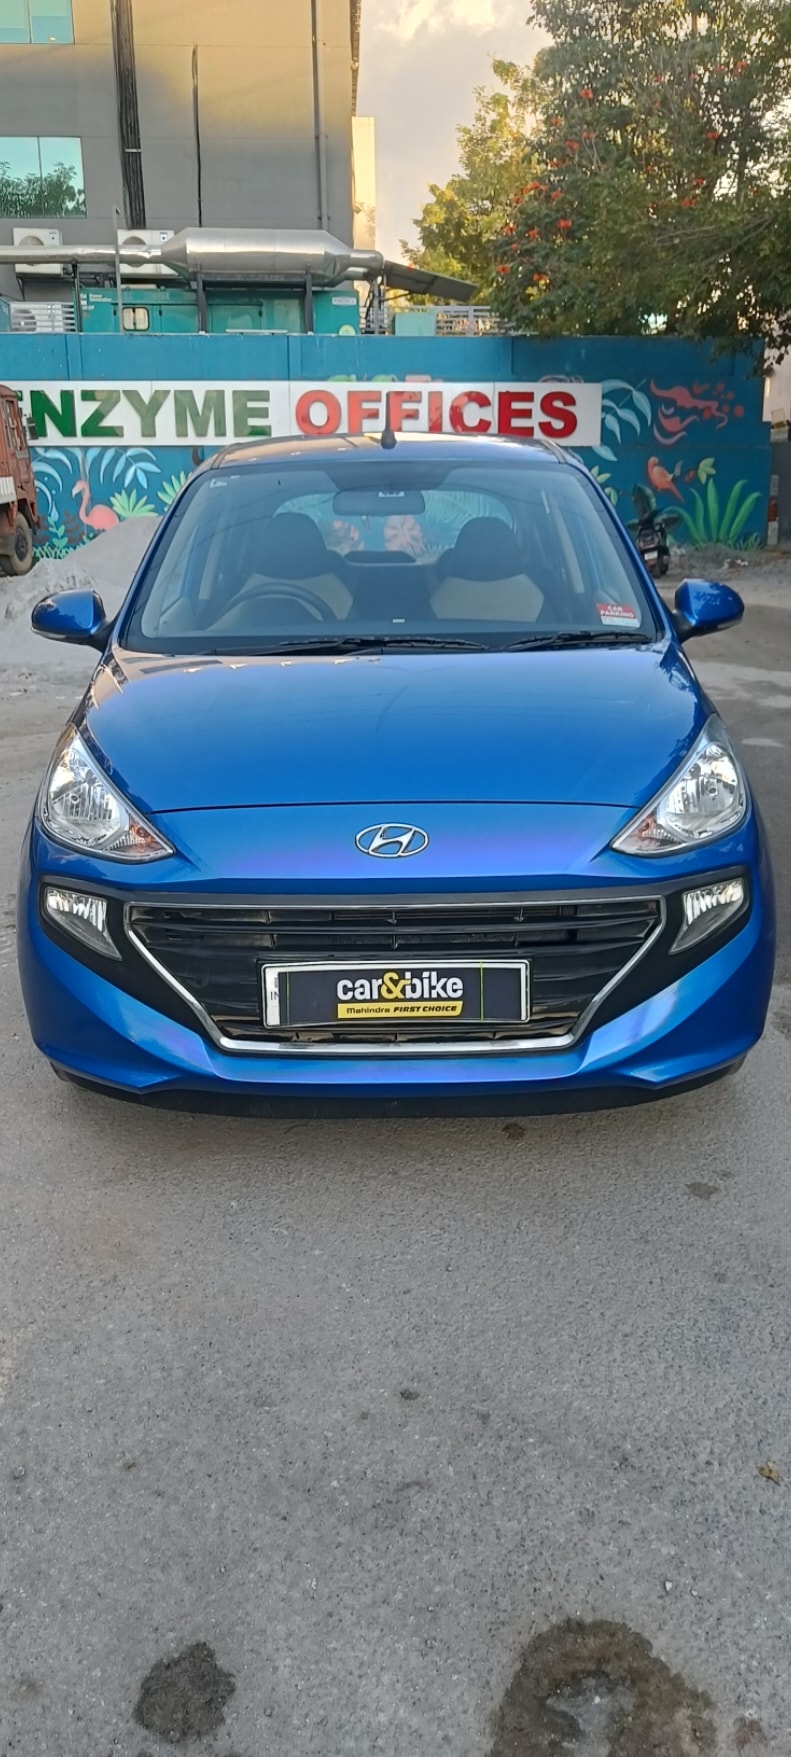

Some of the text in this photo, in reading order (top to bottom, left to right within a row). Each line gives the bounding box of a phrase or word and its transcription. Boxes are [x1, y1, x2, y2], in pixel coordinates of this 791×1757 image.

[16, 389, 578, 439] NZYME OFFICES
[600, 610, 634, 618] PARKING
[337, 971, 464, 1001] car&bike
